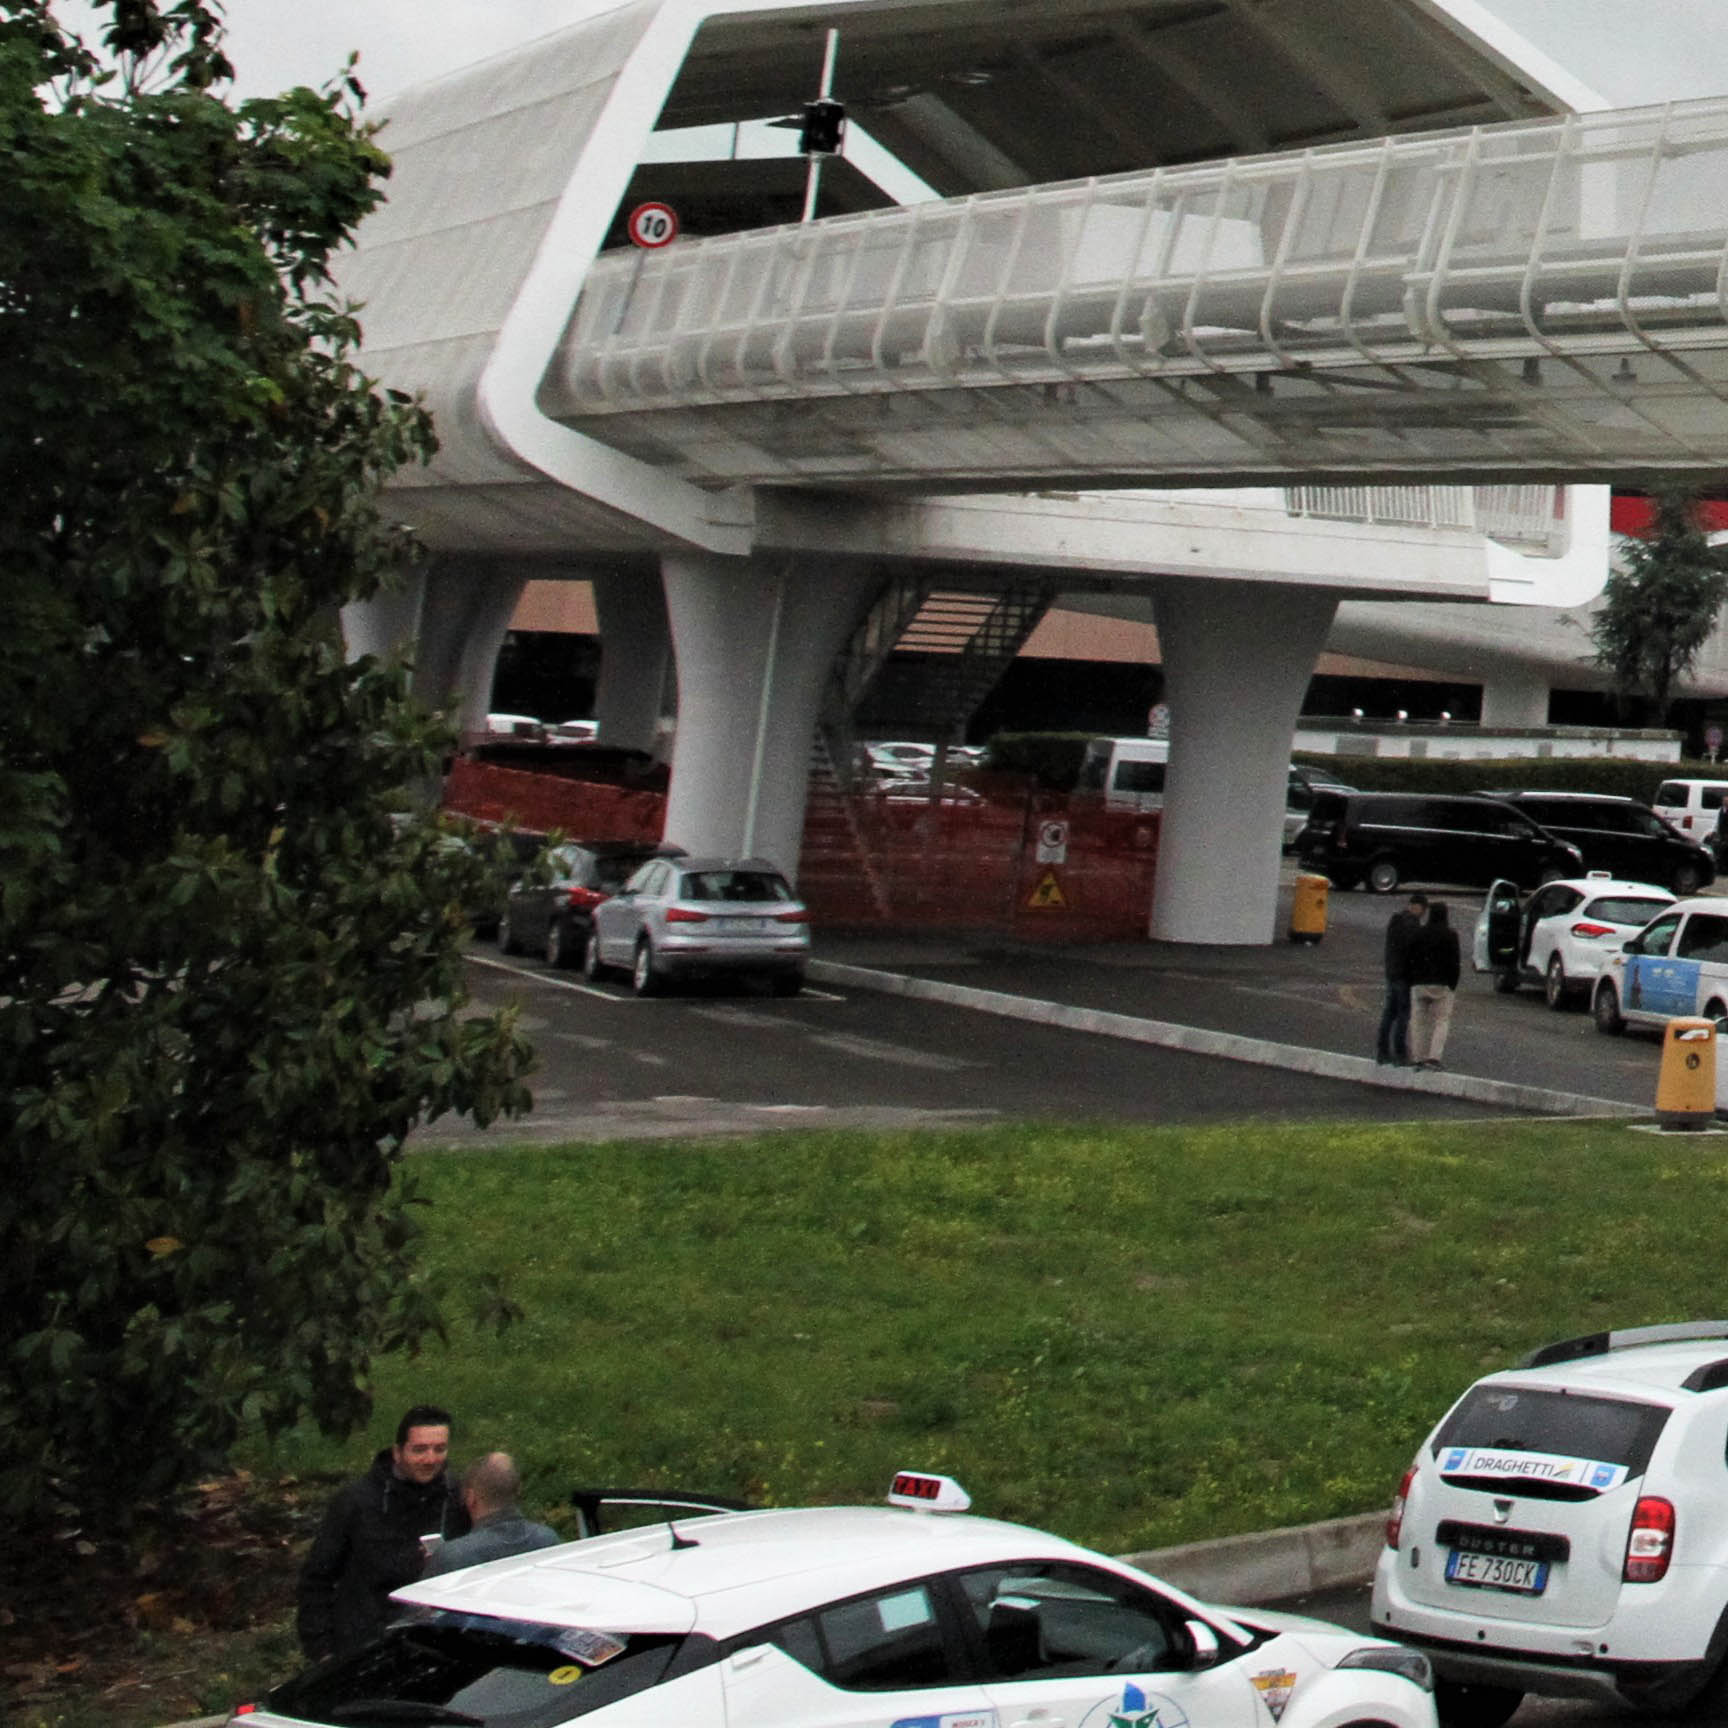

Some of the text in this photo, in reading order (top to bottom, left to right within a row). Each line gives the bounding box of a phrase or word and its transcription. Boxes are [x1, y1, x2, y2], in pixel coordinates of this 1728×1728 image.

[643, 215, 667, 238] 10
[1473, 1456, 1555, 1477] DRAGHETTI
[892, 1475, 941, 1500] TAXI
[1457, 1536, 1536, 1556] DUSTER
[1456, 1554, 1537, 1587] FE 730CK
